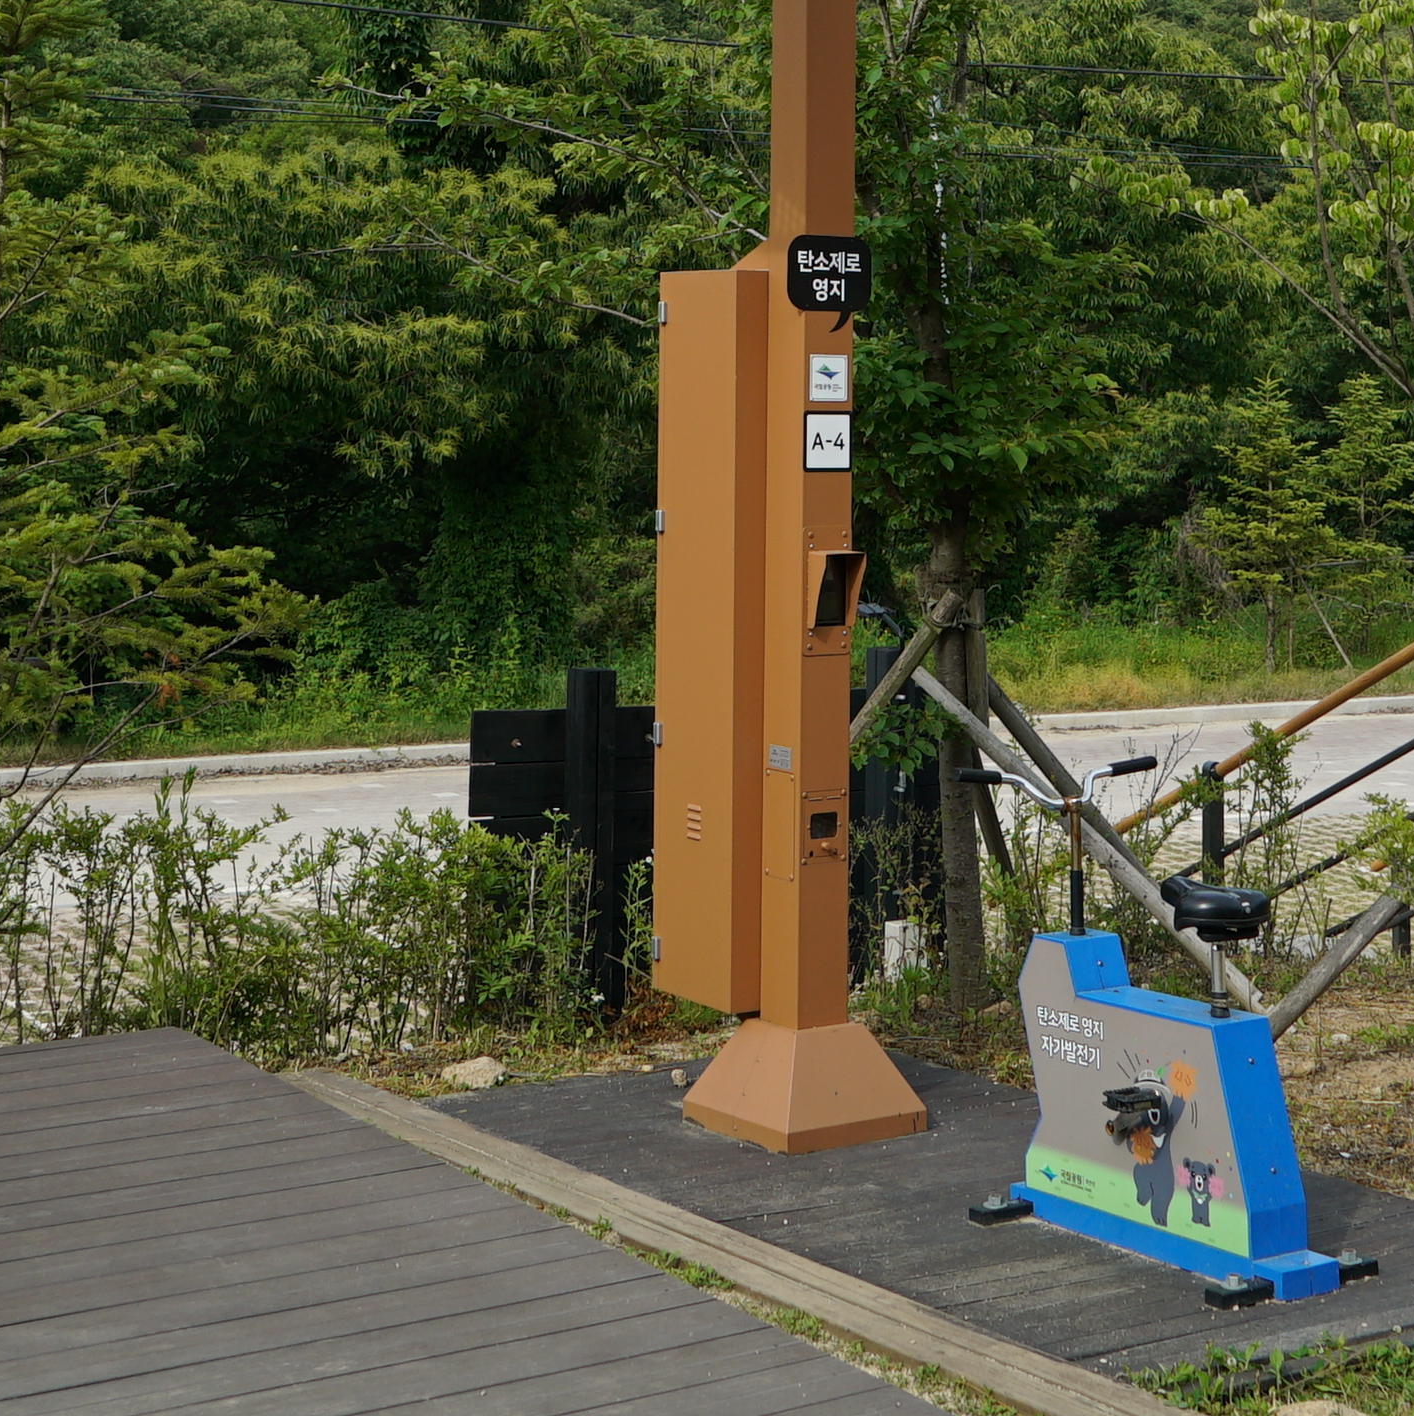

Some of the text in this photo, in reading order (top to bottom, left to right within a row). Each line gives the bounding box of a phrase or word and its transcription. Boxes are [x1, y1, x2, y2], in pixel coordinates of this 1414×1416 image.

[797, 249, 862, 275] 탄소제로
[812, 277, 846, 302] 영지
[811, 431, 846, 451] A-4
[1036, 1005, 1104, 1041] 탄소제로 영지
[1040, 1034, 1101, 1070] 자가발전기
